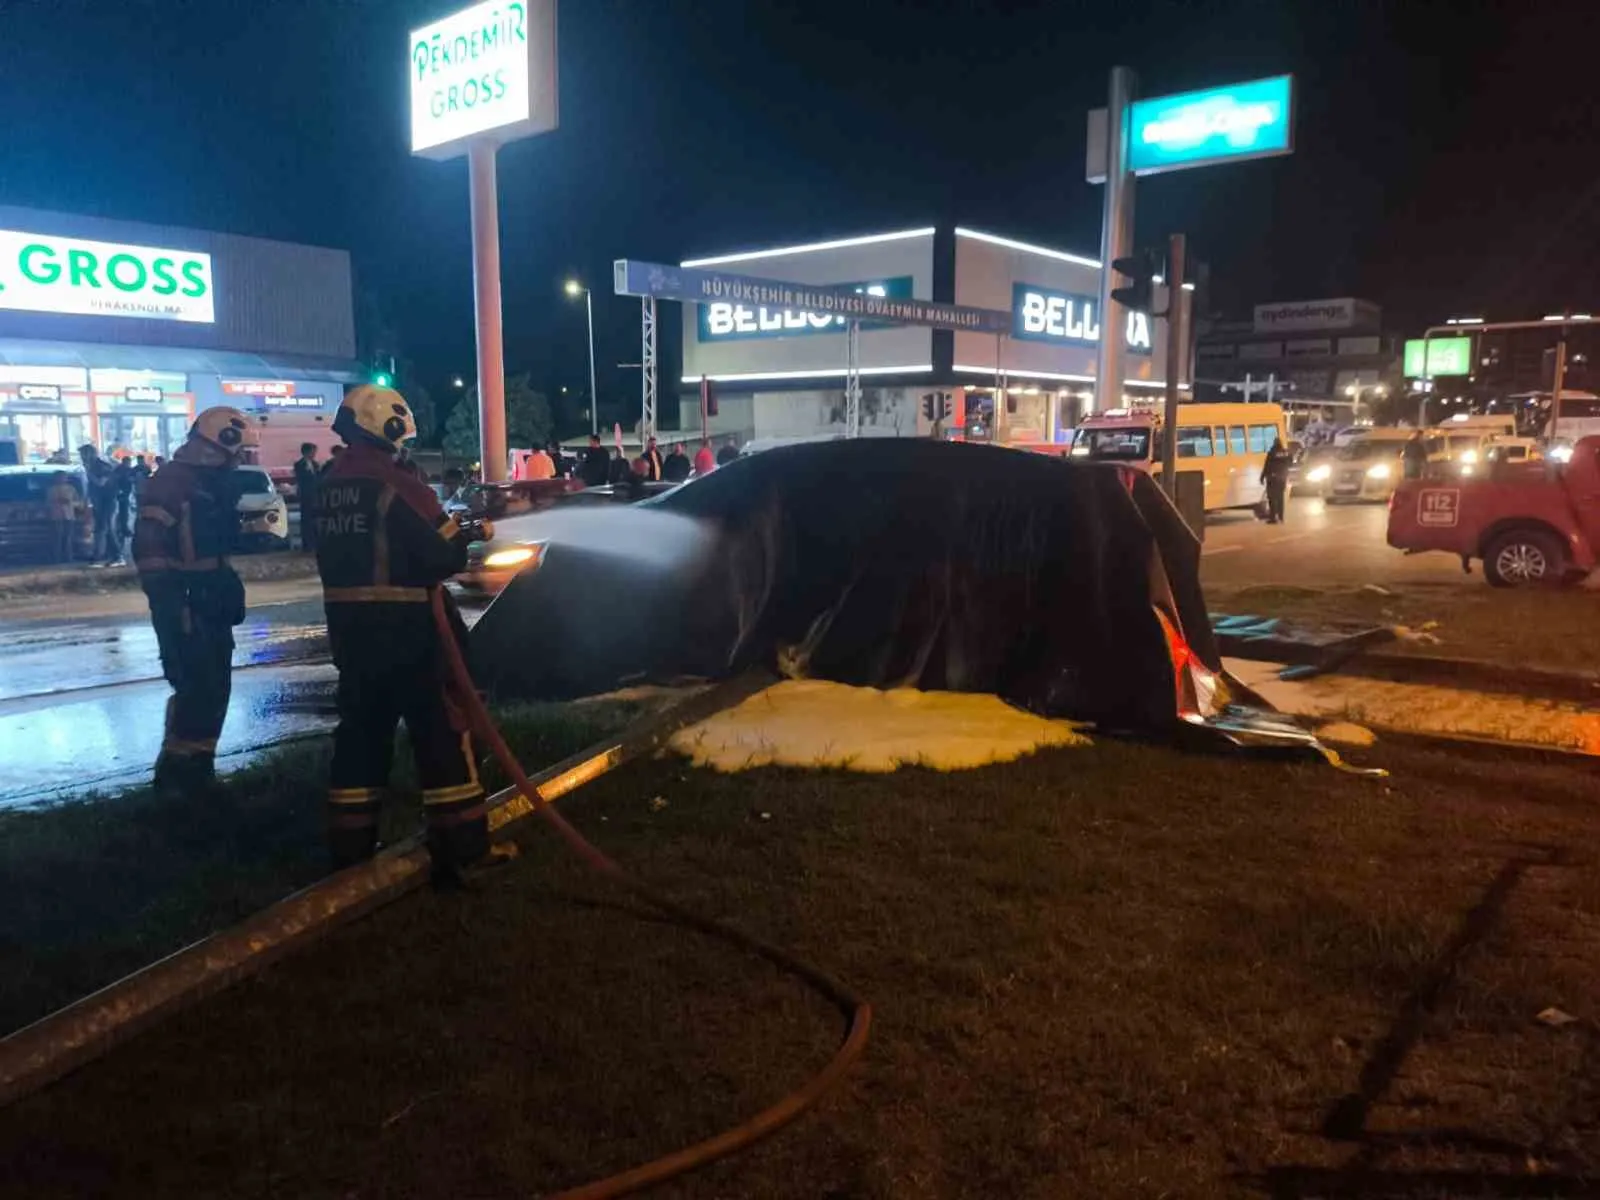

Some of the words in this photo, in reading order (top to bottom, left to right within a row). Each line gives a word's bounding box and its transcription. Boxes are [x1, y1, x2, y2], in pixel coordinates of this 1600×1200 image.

[431, 68, 507, 118] GROSS
[18, 244, 207, 298] GROSS
[702, 277, 791, 304] BÜYÜKŞEHİR
